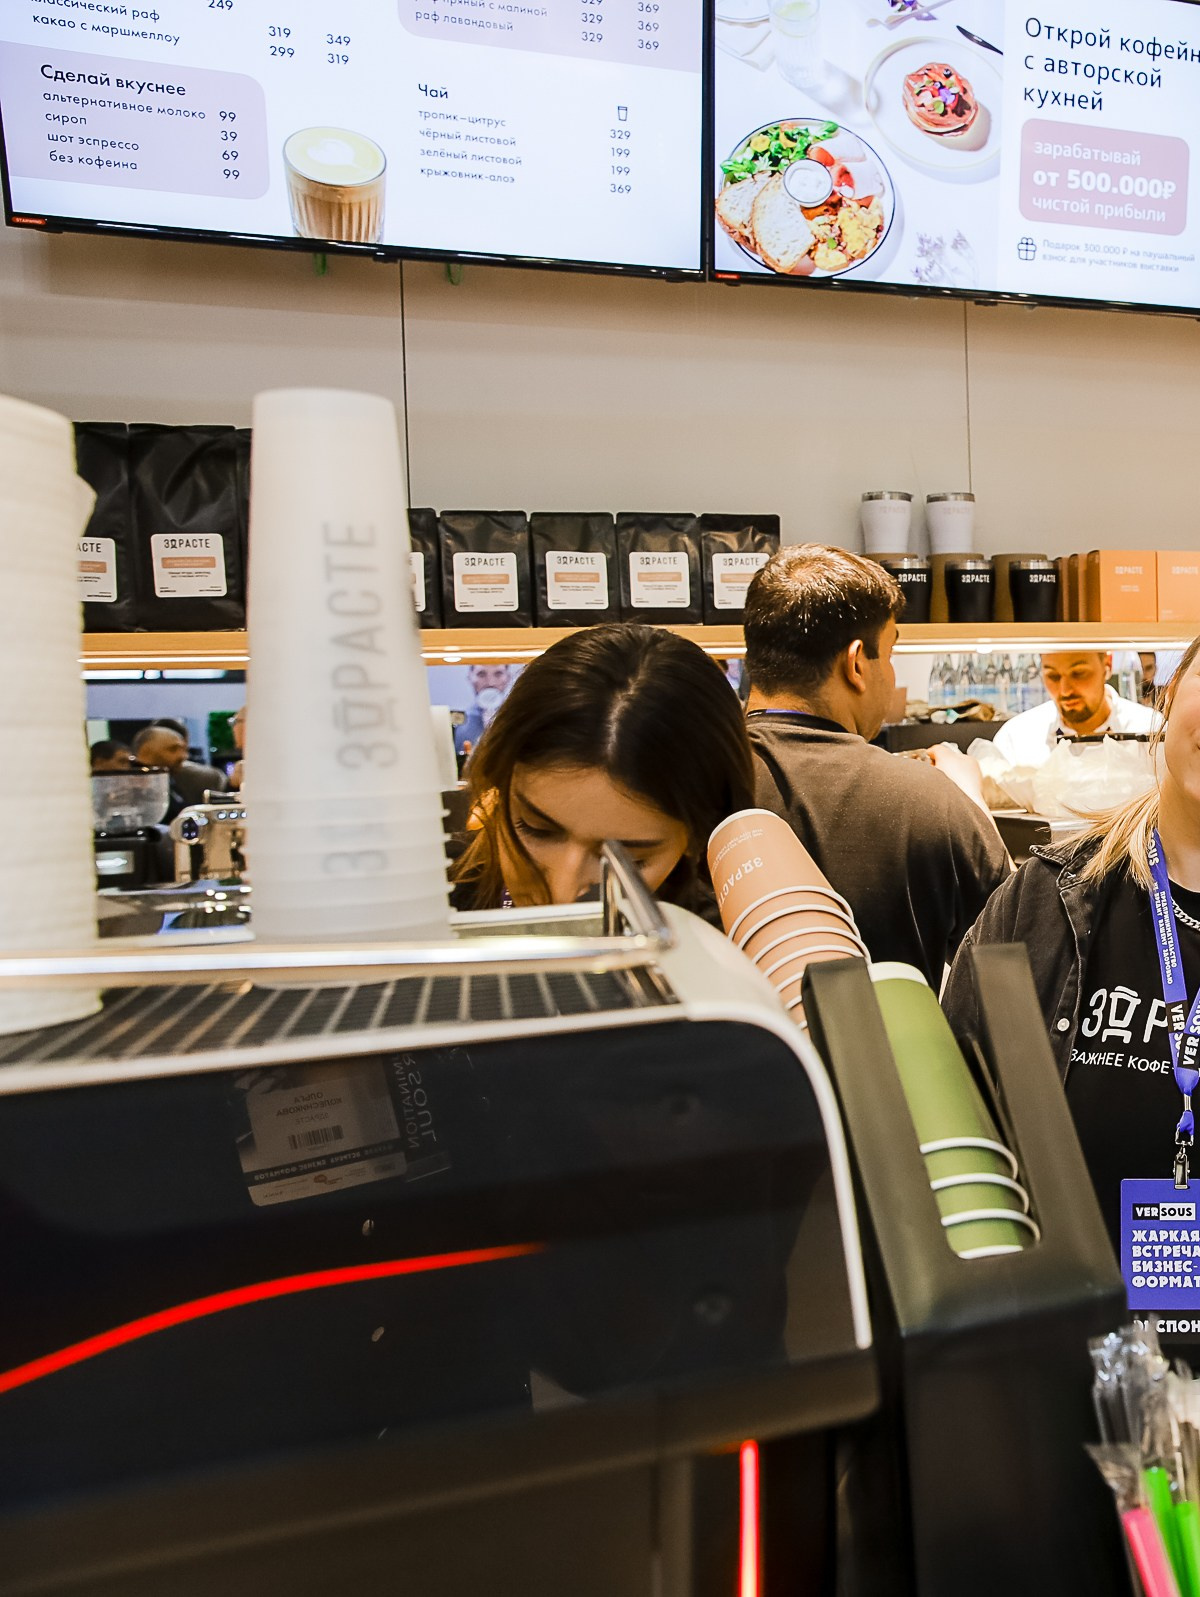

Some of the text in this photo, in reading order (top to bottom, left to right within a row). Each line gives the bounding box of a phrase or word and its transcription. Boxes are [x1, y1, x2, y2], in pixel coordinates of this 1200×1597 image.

[31, 0, 160, 22] ассический раф
[208, 0, 233, 10] 249
[498, 4, 547, 16] малиной
[637, 2, 660, 13] 369
[33, 15, 180, 45] какао с маршмеллоу
[415, 11, 513, 31] раф лавандовый
[581, 12, 660, 32] 329 369
[268, 26, 351, 46] 319 349
[581, 31, 660, 50] 329 369
[1025, 17, 1110, 49] Открой
[269, 45, 349, 65] 299 319
[41, 64, 186, 96] Сделай вкуснее
[1024, 55, 1162, 88] с авторской
[418, 83, 448, 99] Чай
[1024, 86, 1103, 111] кухней
[43, 90, 236, 122] альтернативное молоко 99
[45, 112, 238, 142] сироп 39
[610, 129, 631, 140] 329
[47, 132, 239, 162] шот эспрессо 69
[419, 128, 516, 147] чёрный листовой
[420, 147, 522, 166] зелёный листовой
[611, 147, 631, 158] 199
[1034, 140, 1141, 166] зарабатывай
[49, 150, 240, 180] без кофеина 99
[611, 165, 631, 177] 199
[610, 183, 632, 195] 369
[1032, 169, 1176, 199] от 500.000₽
[1032, 197, 1166, 223] чистой прибыли
[719, 857, 763, 908] ЗДРАСТ
[1135, 1206, 1193, 1218] VERSOUS
[1132, 1229, 1200, 1243] ЖАРКАЯ
[1132, 1260, 1198, 1273] БИЗНЕС-
